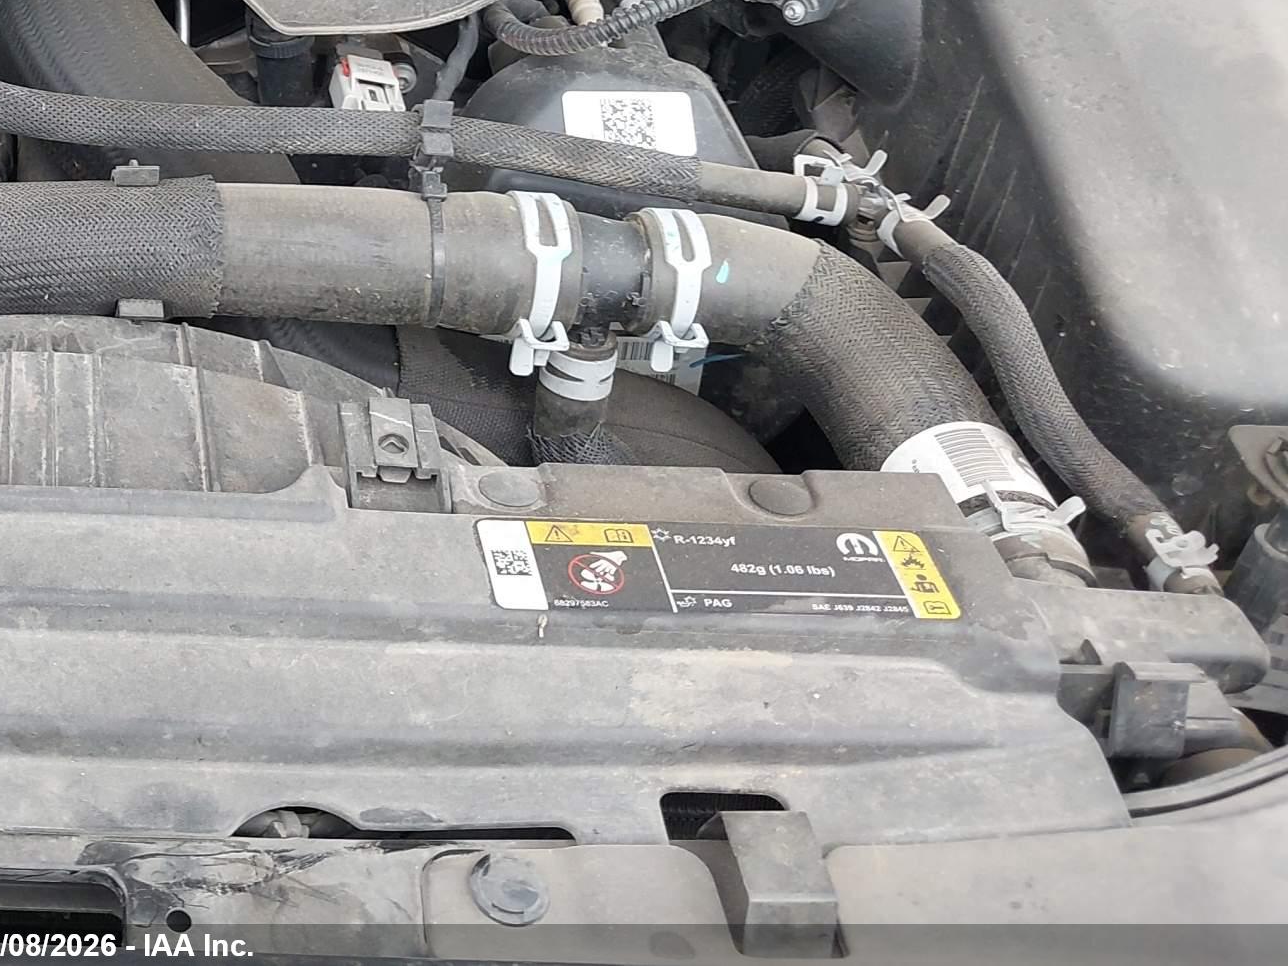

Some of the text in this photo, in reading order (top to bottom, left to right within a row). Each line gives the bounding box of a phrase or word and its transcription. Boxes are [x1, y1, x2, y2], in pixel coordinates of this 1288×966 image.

[673, 535, 736, 548] R-1234yf
[730, 563, 836, 578] 482g (1.06 lbs)
[703, 597, 733, 609] PAG
